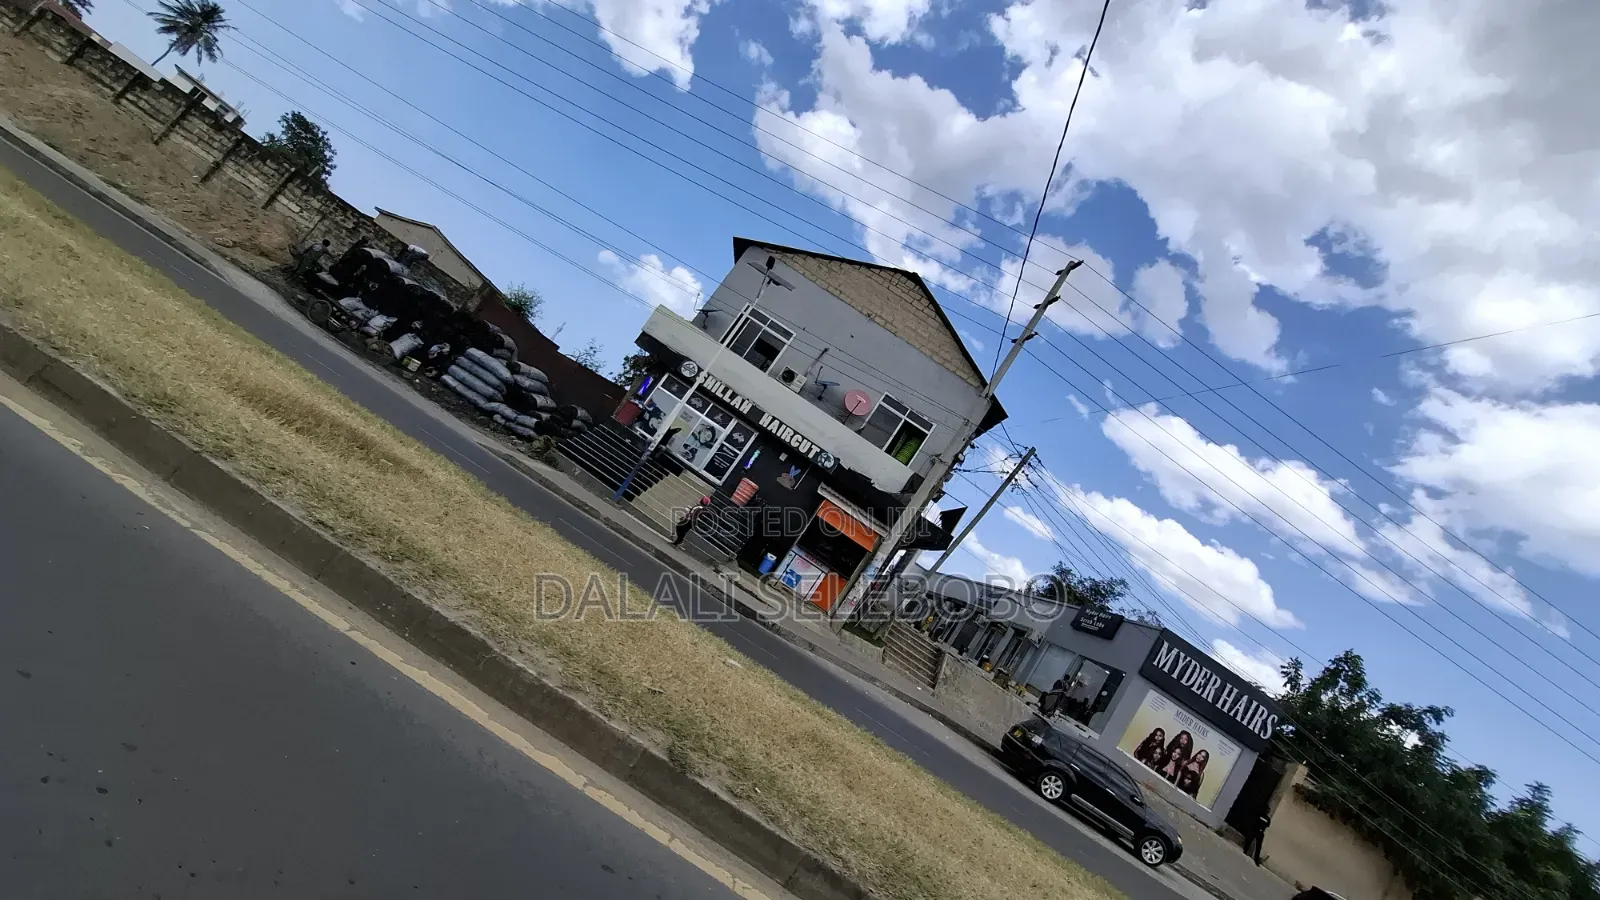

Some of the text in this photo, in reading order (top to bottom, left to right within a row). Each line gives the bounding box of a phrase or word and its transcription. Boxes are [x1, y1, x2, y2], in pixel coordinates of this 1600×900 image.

[696, 371, 821, 460] SHILLAH HAIRCUT
[1153, 640, 1279, 740] MYDER HAIRS
[1175, 709, 1194, 728] MYDER
[1193, 720, 1211, 738] HAIRS
